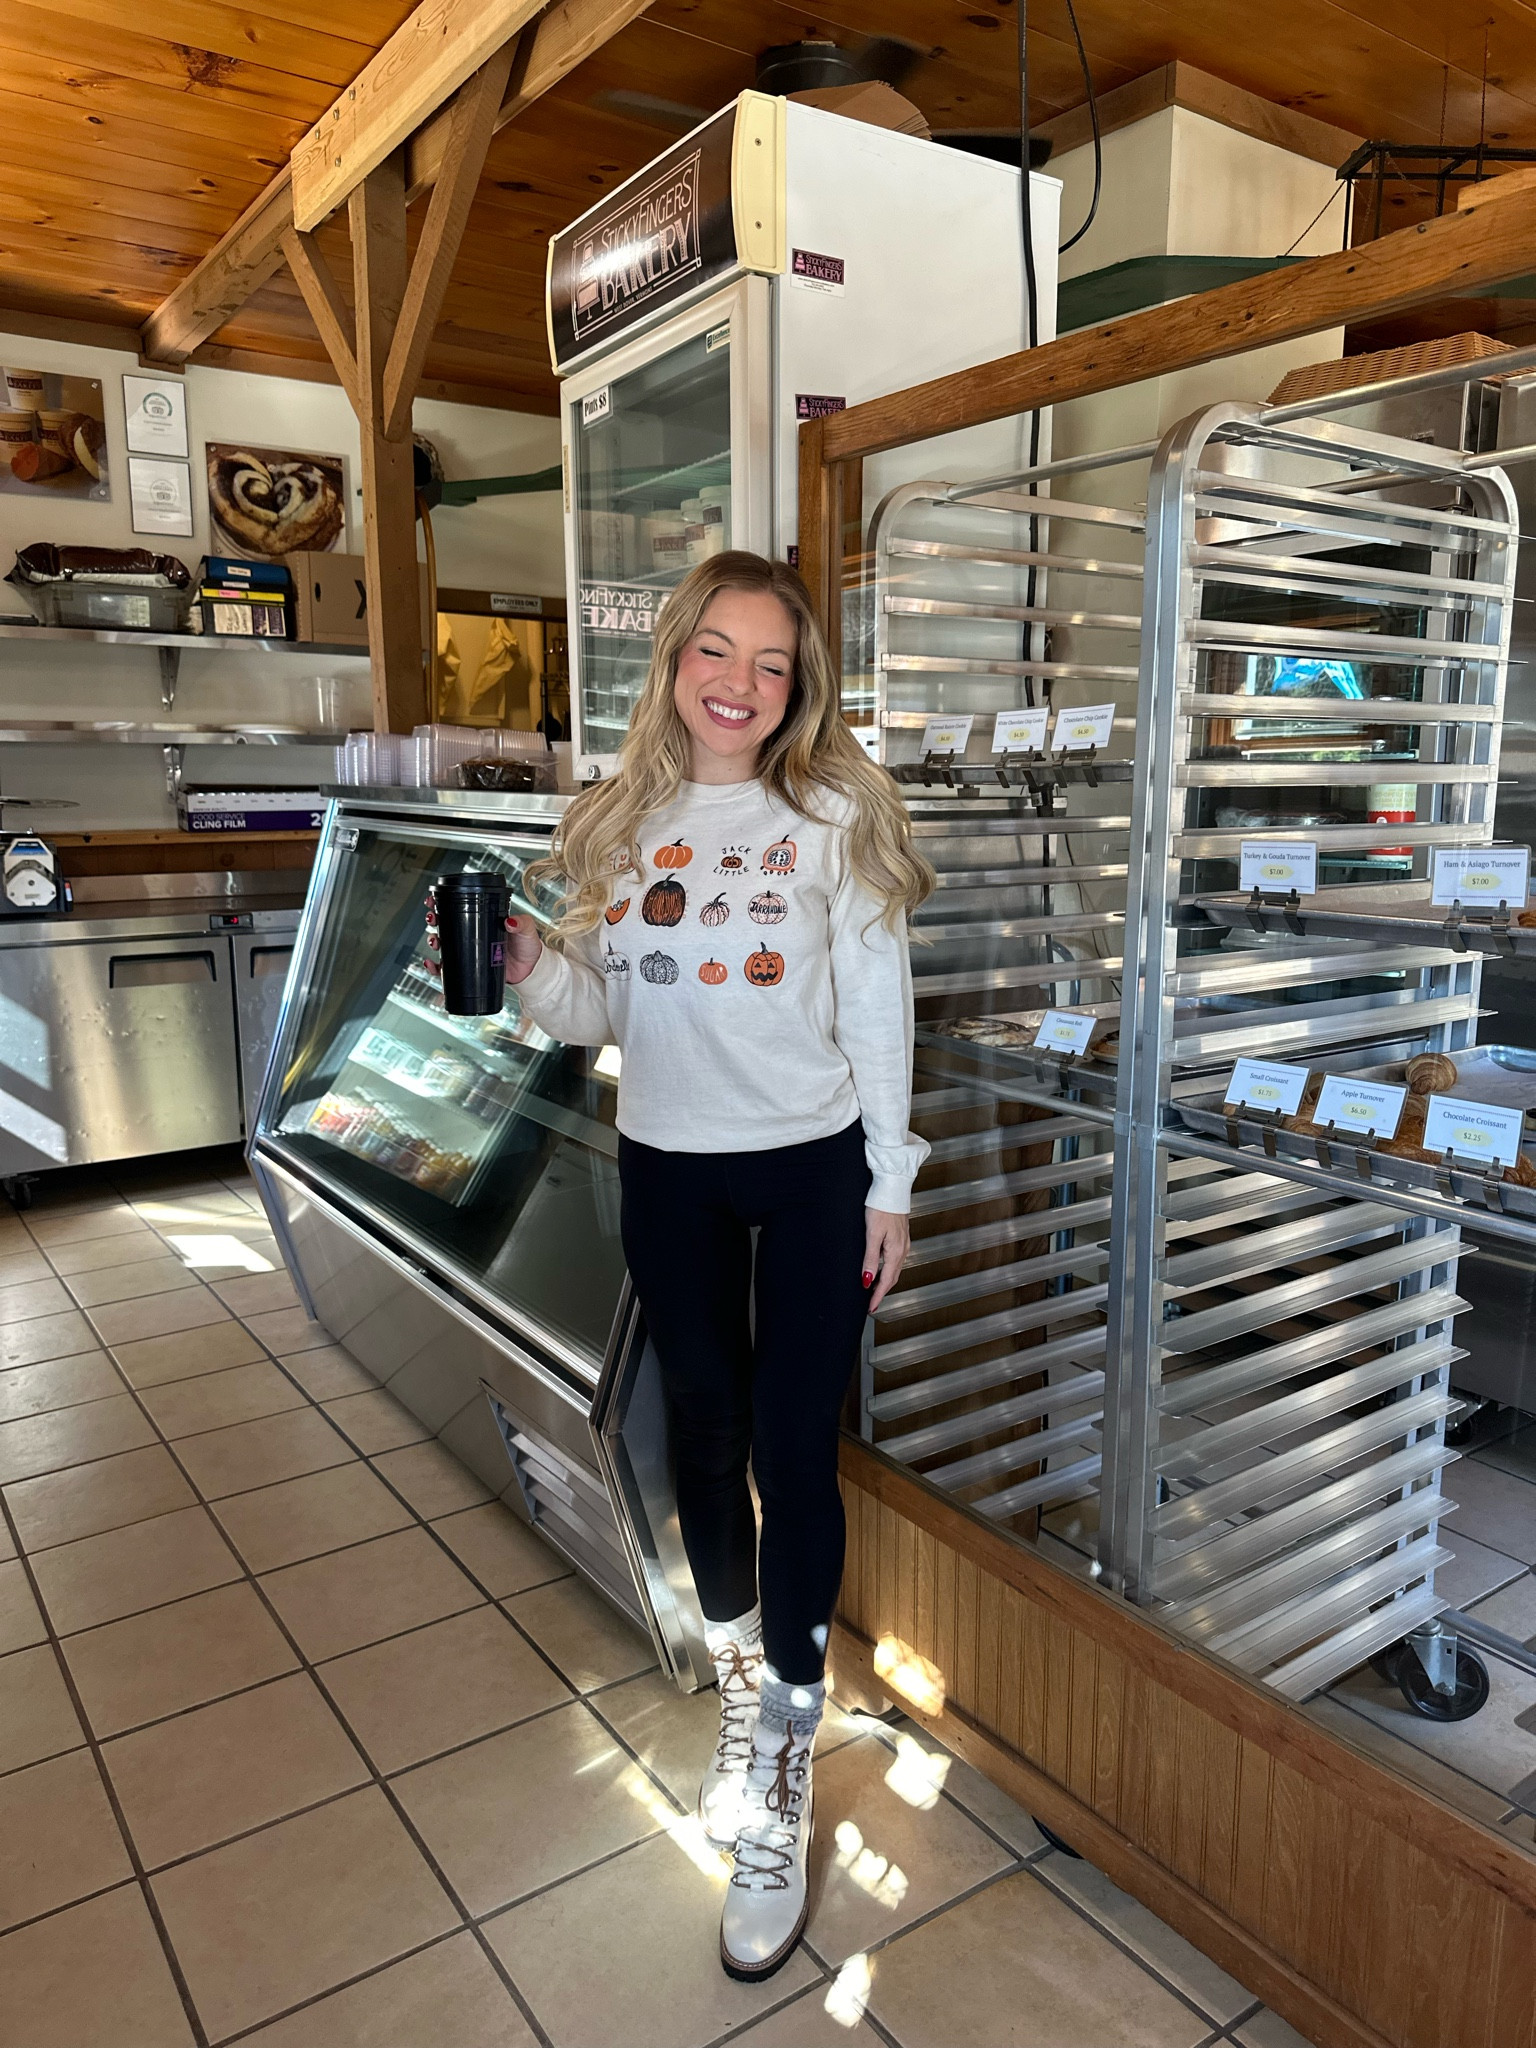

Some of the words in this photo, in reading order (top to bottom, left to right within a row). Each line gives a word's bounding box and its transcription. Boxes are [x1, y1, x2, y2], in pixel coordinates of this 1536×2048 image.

[601, 211, 692, 311] BAKERY
[806, 264, 842, 281] BAKERY
[584, 398, 598, 416] Pints
[599, 392, 607, 409] $8
[493, 598, 525, 606] EMPLOYEES
[193, 820, 222, 829] CLING
[224, 820, 246, 828] FILM
[721, 845, 752, 855] JACK
[1468, 860, 1490, 868] Asiago
[713, 866, 749, 876] LITTLE
[700, 966, 725, 982] SUGAR
[1250, 1072, 1264, 1080] Small
[1265, 1075, 1288, 1084] Croissant
[1258, 1088, 1272, 1096] $1.75
[1342, 1090, 1358, 1098] Apple
[1360, 1092, 1384, 1102] Turnover
[1350, 1106, 1367, 1115] $6.50
[1443, 1112, 1474, 1123] Chocolate
[1476, 1117, 1507, 1129] Croissant
[1464, 1132, 1481, 1142] $2.25
